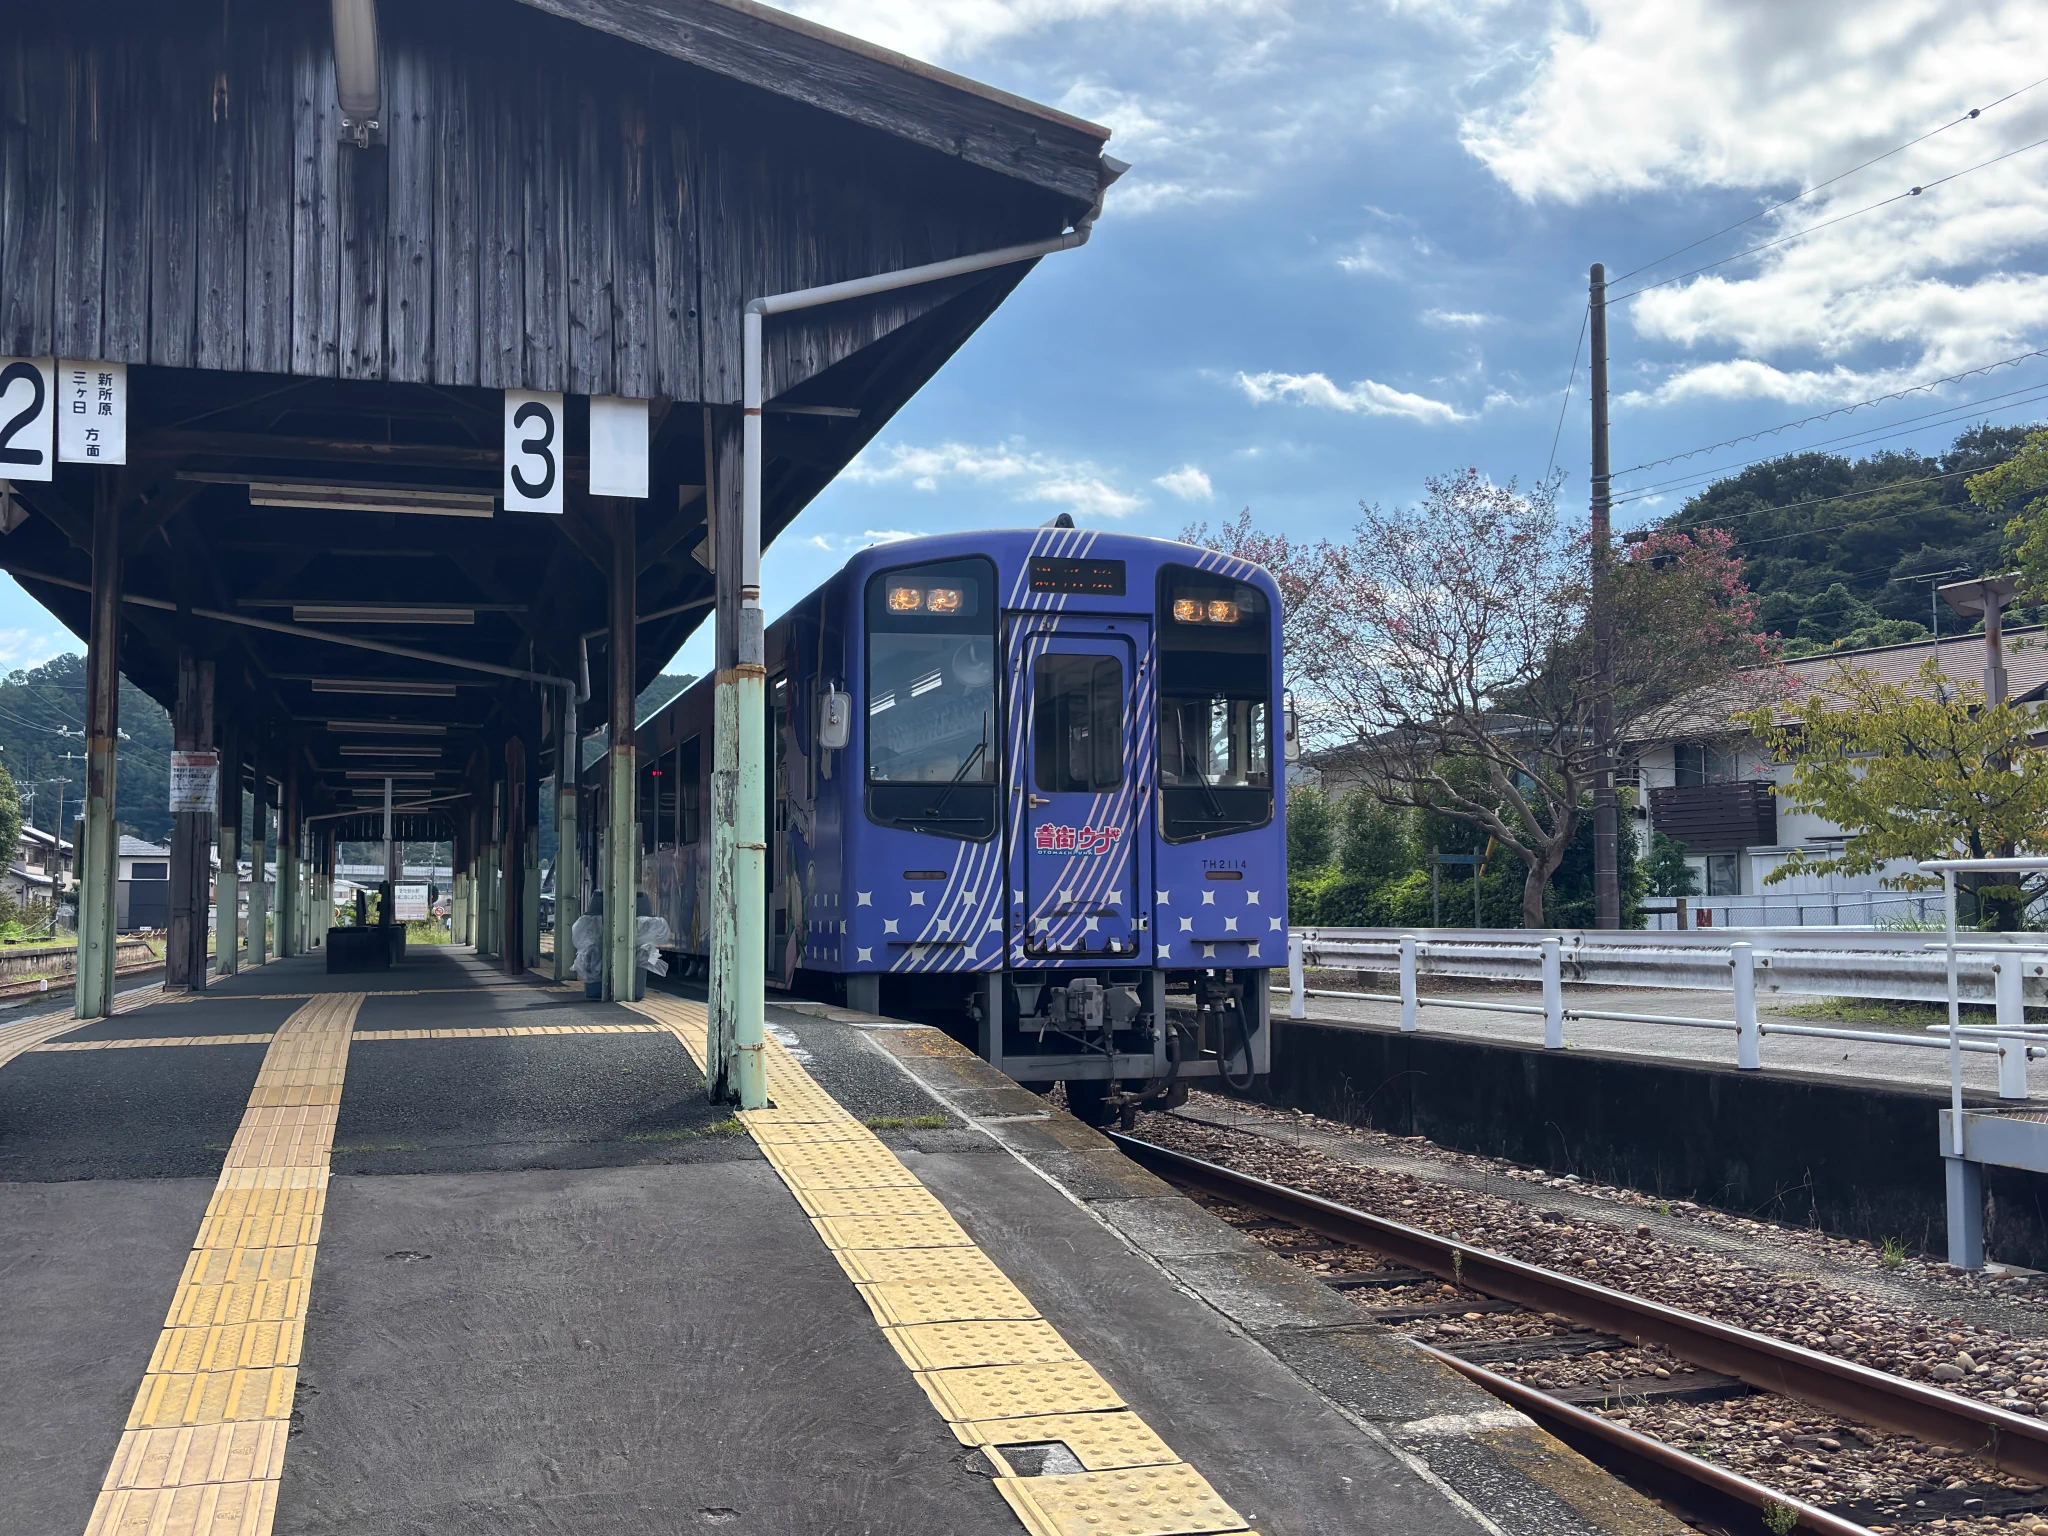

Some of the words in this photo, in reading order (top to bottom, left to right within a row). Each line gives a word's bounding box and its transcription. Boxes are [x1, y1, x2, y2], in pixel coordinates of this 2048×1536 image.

[98, 372, 113, 416] 新所原
[0, 362, 45, 466] 2
[85, 428, 100, 457] 方面
[511, 401, 556, 499] 3
[1034, 823, 1121, 855] 音街ウナ
[1202, 860, 1247, 869] TH2114
